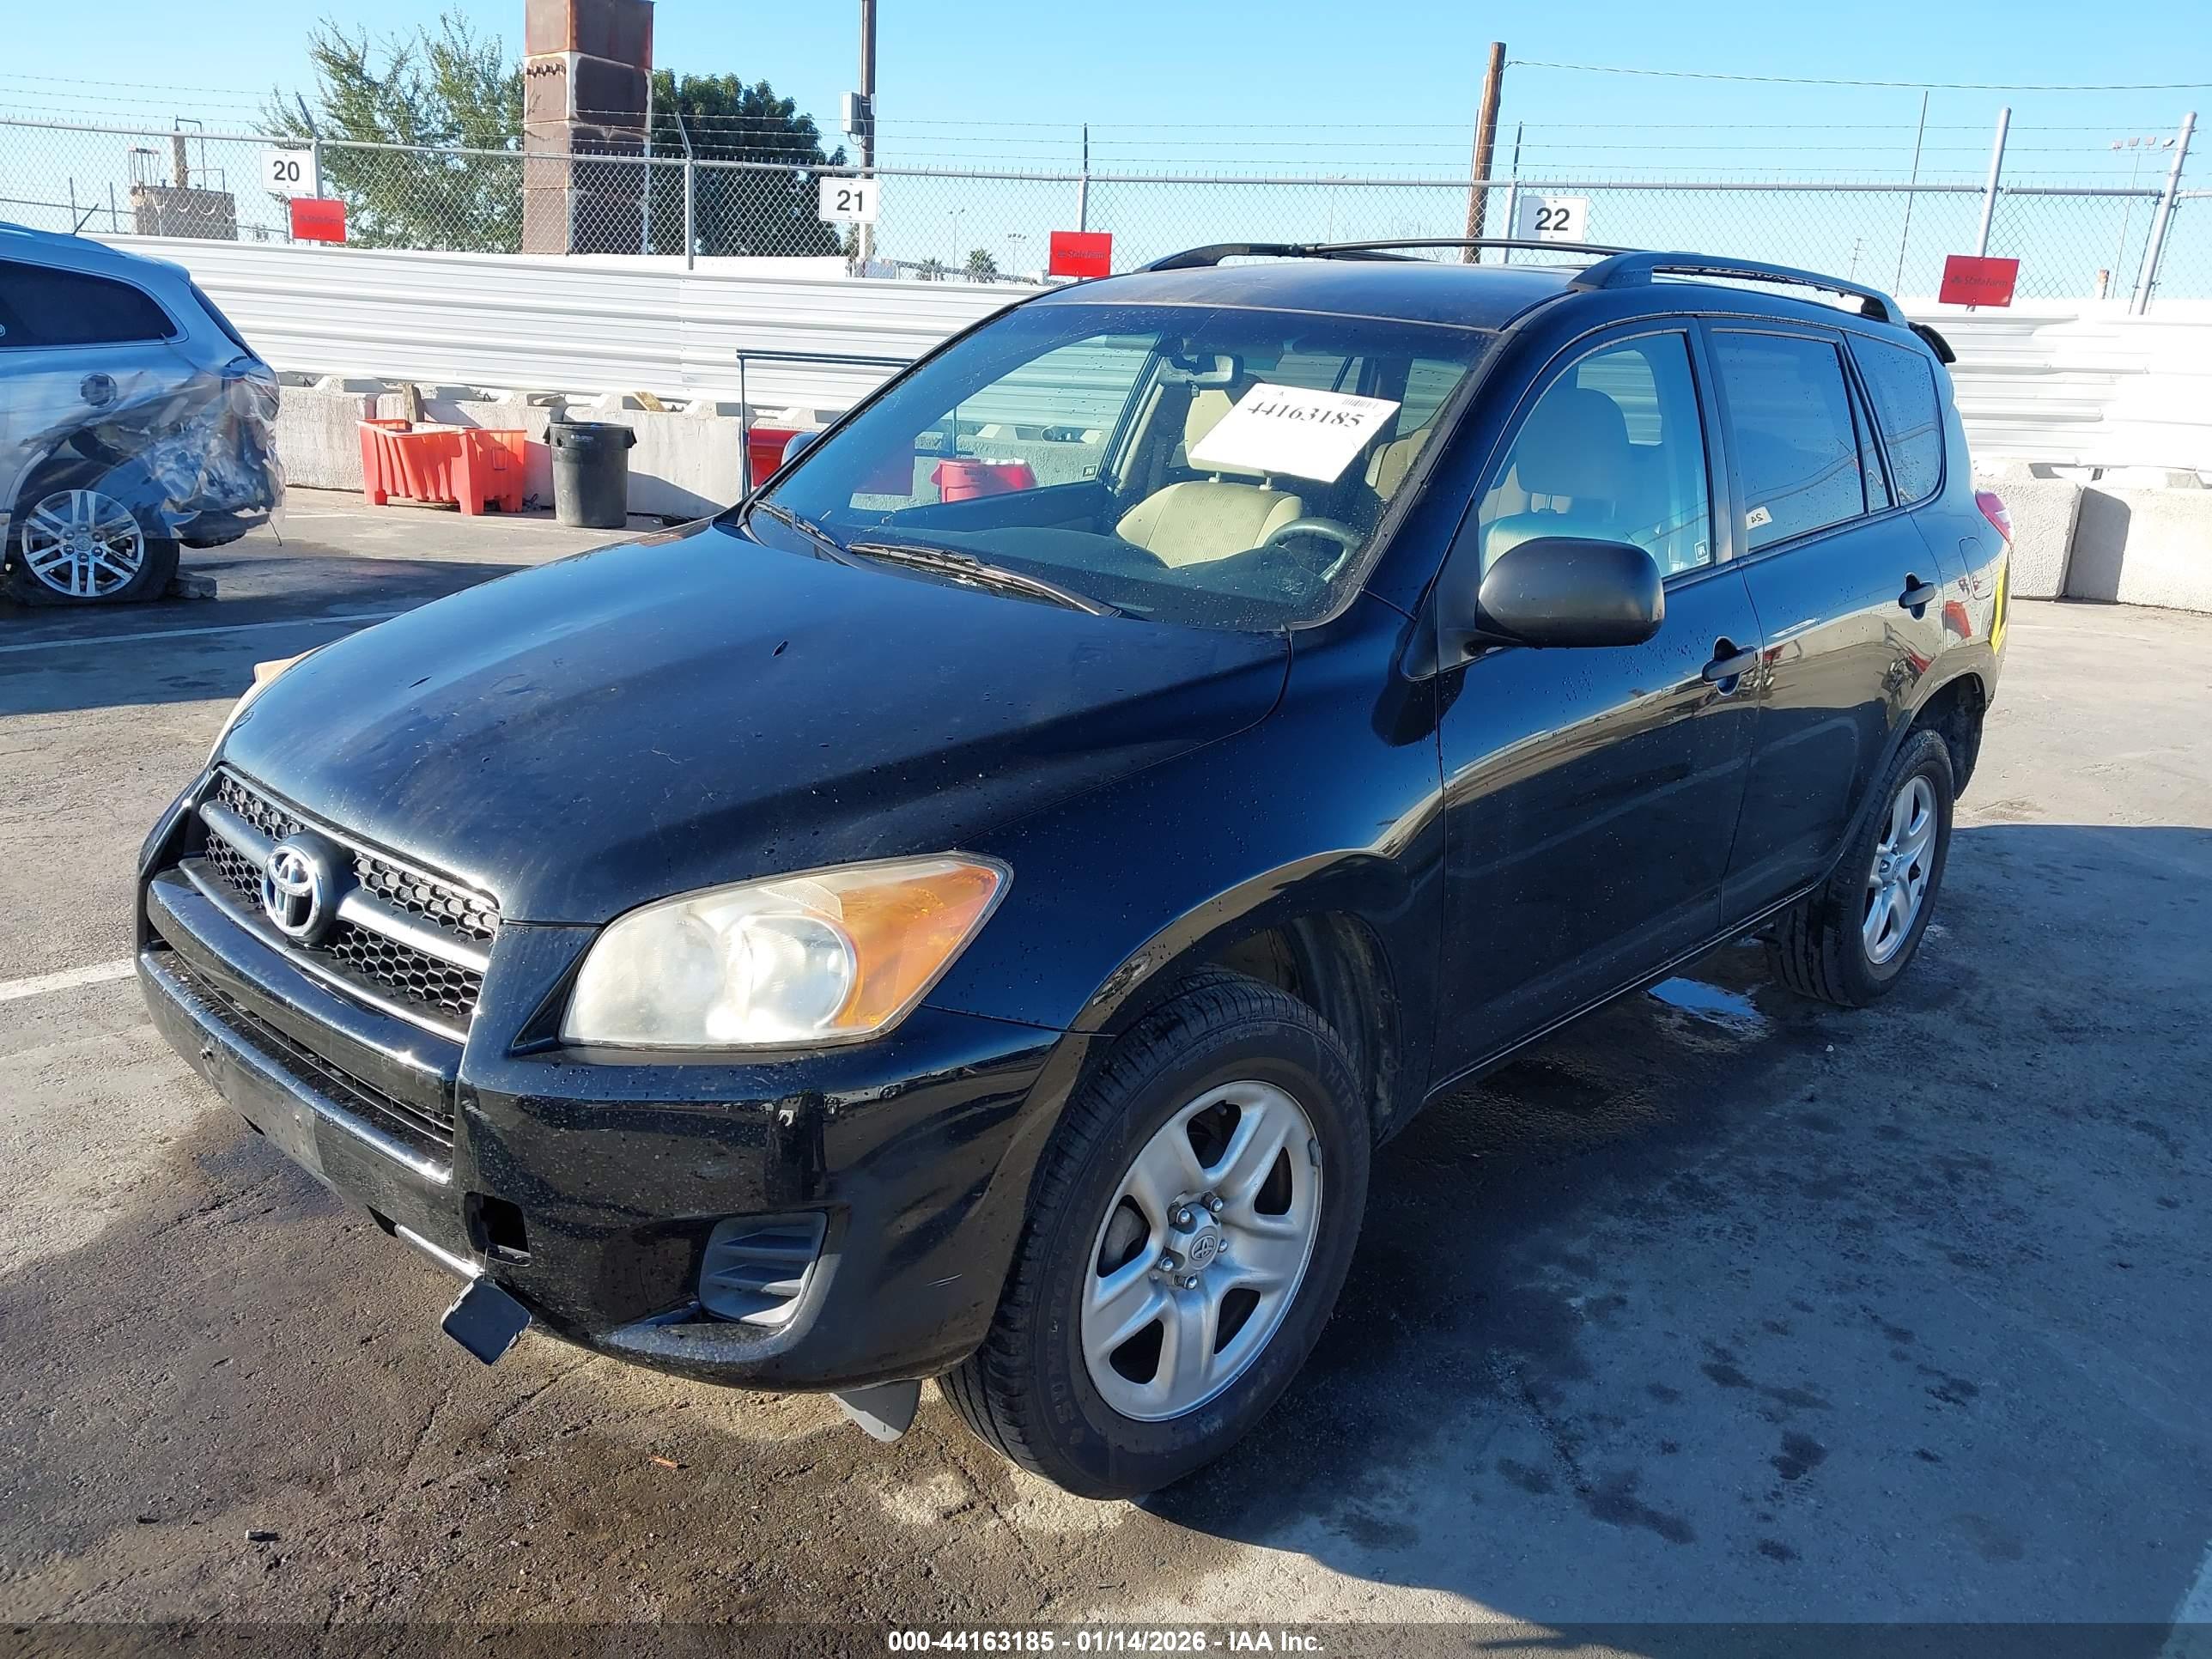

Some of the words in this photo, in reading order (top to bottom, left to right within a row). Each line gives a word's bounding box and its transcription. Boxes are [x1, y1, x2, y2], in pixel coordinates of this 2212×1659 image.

[273, 161, 301, 182] 20
[836, 189, 863, 212] 21
[1534, 207, 1571, 231] 22
[1247, 401, 1365, 428] 44163185
